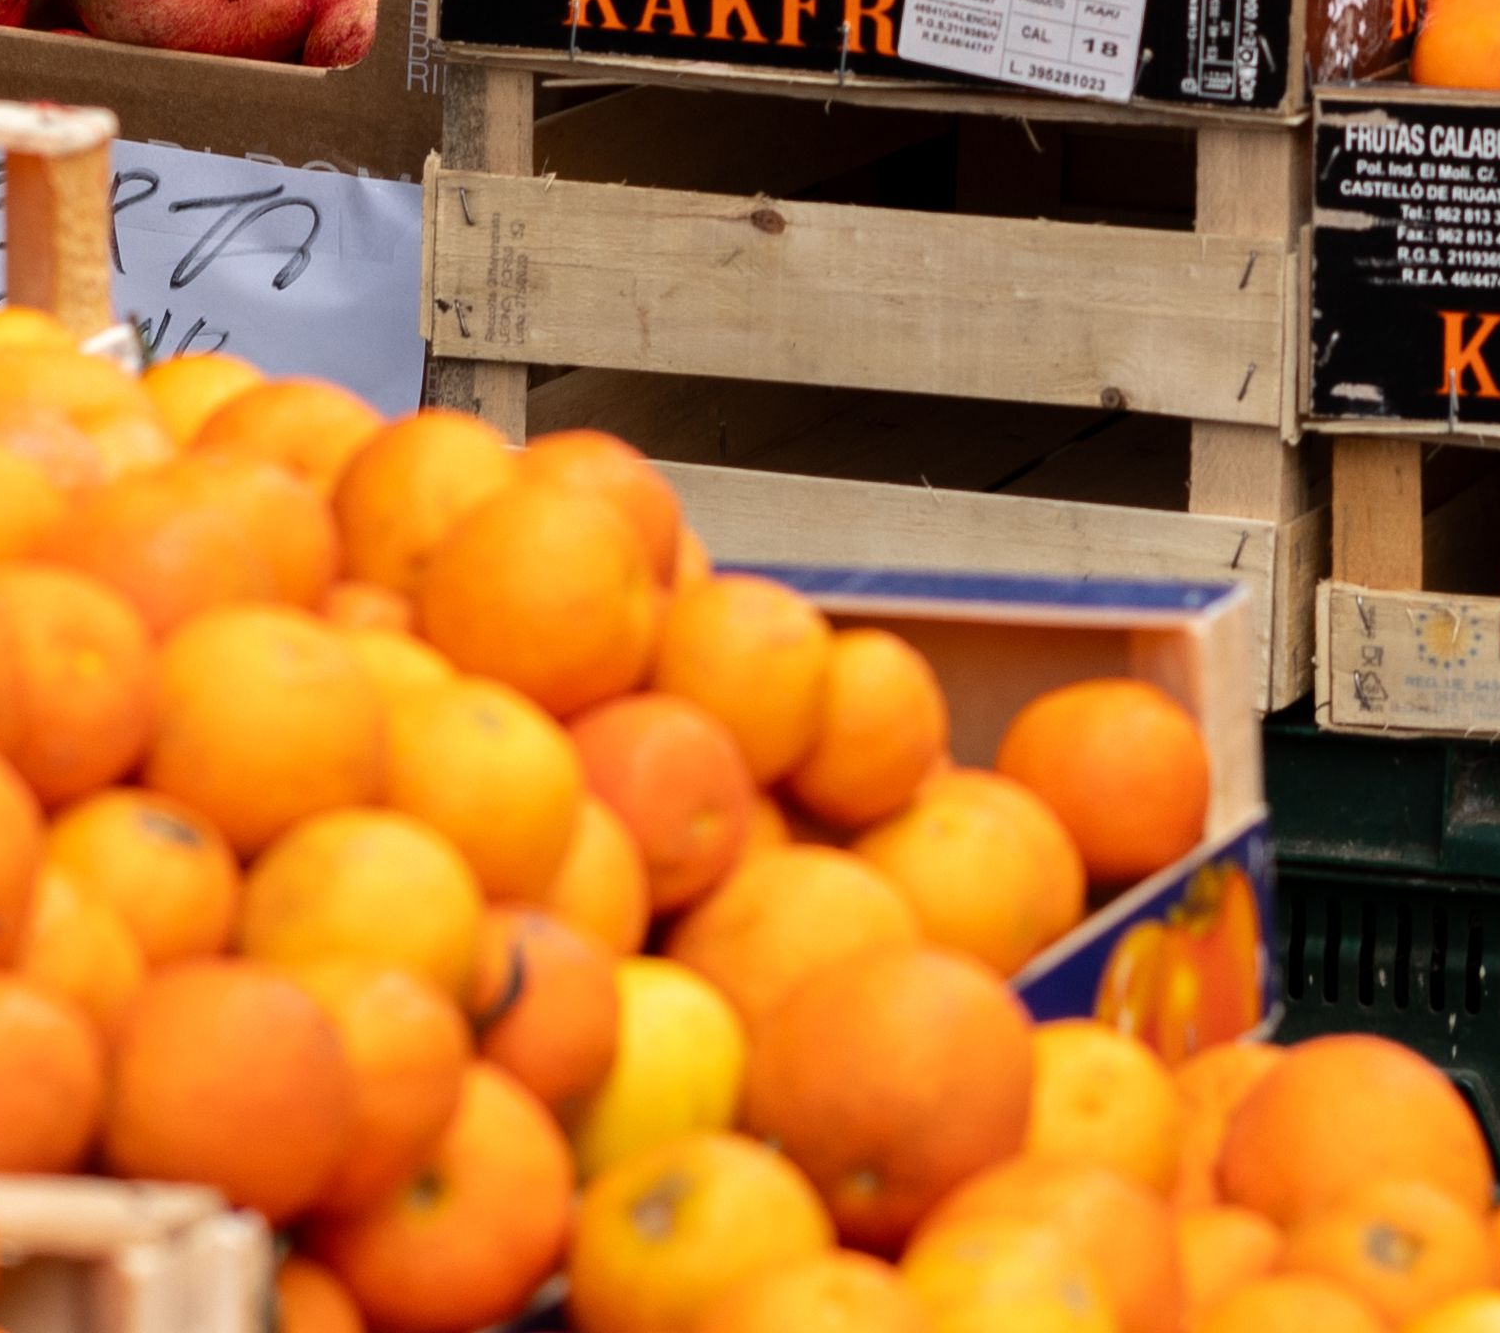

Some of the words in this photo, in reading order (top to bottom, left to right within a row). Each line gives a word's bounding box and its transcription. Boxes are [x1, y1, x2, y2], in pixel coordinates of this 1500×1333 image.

[1084, 4, 1120, 19] KAKI
[1021, 26, 1051, 44] CAL.
[1083, 38, 1119, 58] 18
[1010, 60, 1023, 75] L.
[1028, 63, 1106, 92] 395281023
[1345, 123, 1425, 156] FRUTAS
[1357, 159, 1385, 176] Pol.
[1389, 161, 1416, 178] Ind.
[1420, 163, 1435, 178] El
[1340, 179, 1423, 199] CASTELLÓ
[1427, 185, 1448, 200] DE
[1401, 204, 1431, 221] Tel.:
[1434, 207, 1461, 222] 962
[1464, 209, 1491, 224] 813
[1397, 225, 1432, 242] Fax.:
[1437, 228, 1463, 244] 962
[1466, 230, 1492, 246] 813
[1397, 246, 1443, 263] R.G.S.
[1402, 268, 1447, 285] R.E.A.
